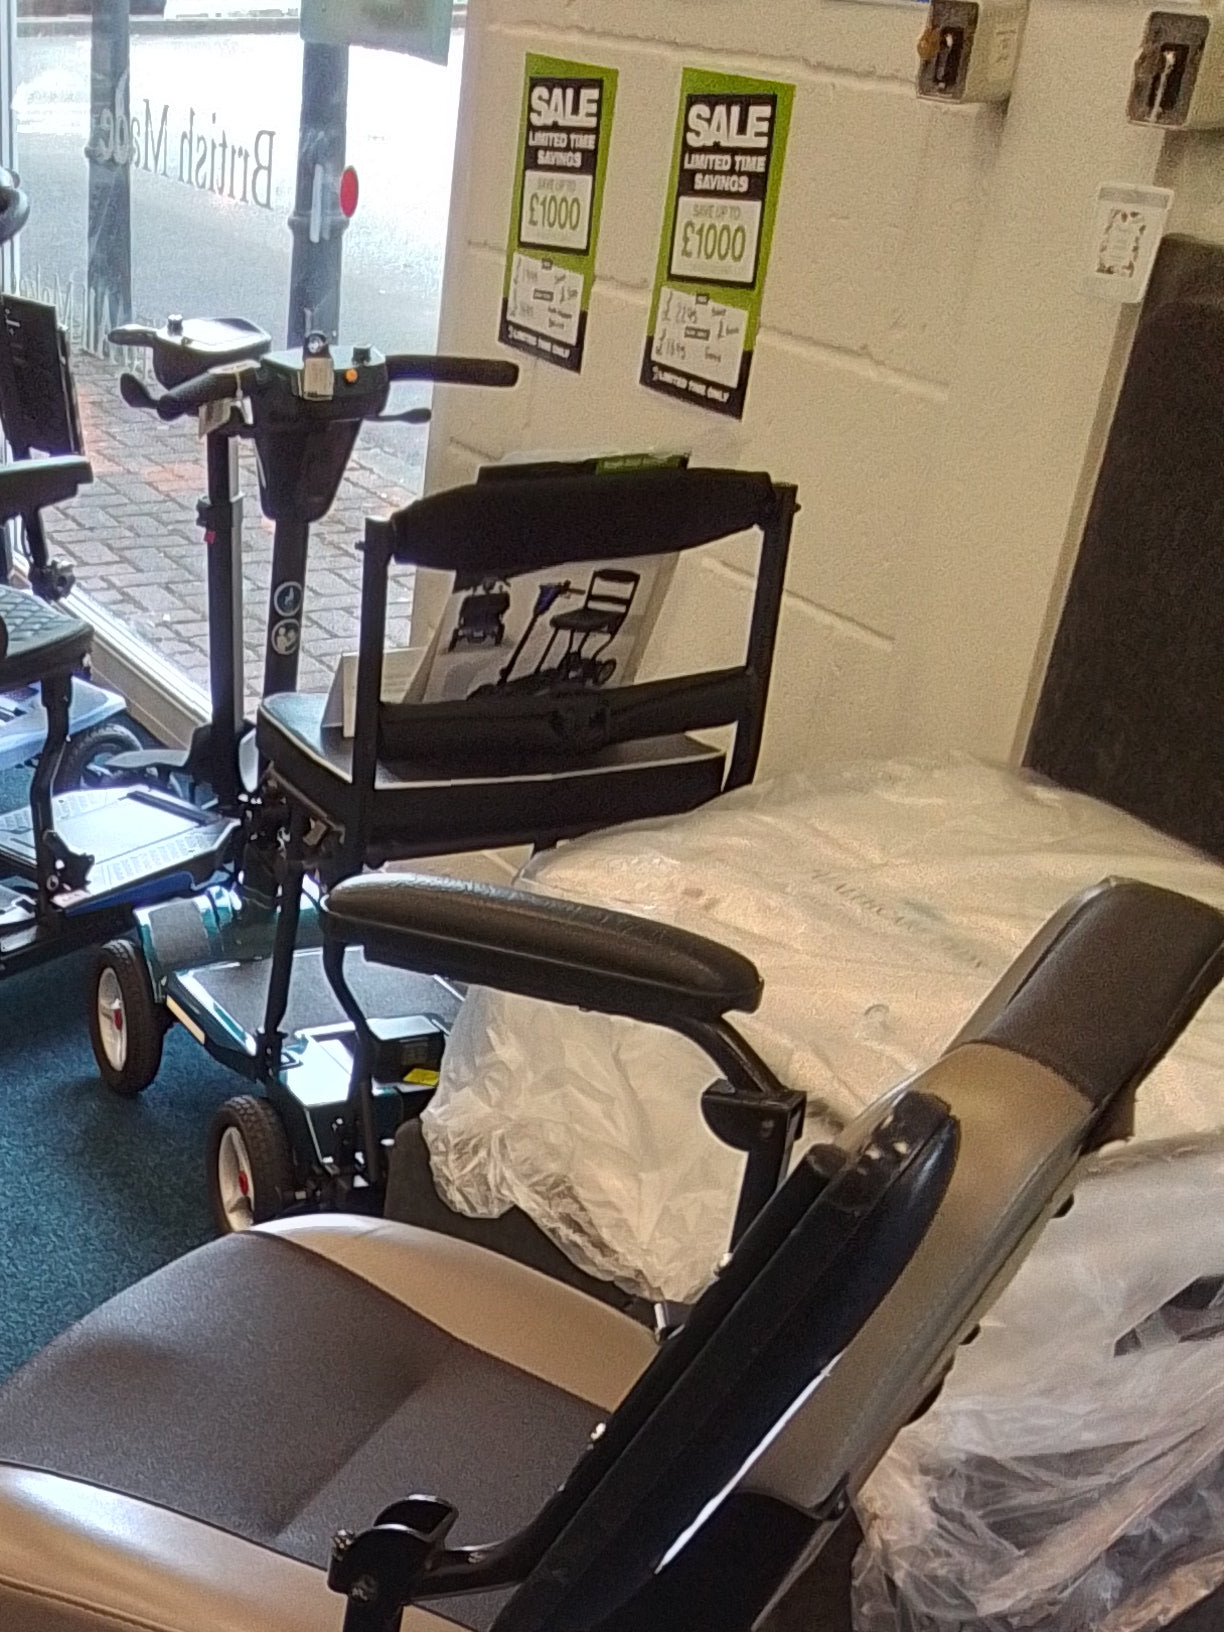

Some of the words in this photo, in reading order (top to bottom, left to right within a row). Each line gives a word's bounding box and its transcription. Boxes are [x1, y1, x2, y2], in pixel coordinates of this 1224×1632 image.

[529, 86, 600, 128] SALE
[686, 104, 772, 148] SALE
[528, 131, 568, 148] LIMITED
[570, 134, 596, 150] TIME
[537, 150, 582, 168] SAVINGS
[683, 153, 731, 171] LIMITED
[734, 155, 766, 173] TIME
[694, 173, 749, 192] SAVINGS
[528, 192, 581, 231] £1000
[693, 204, 715, 218] SAVE
[715, 205, 728, 219] UP
[728, 206, 741, 219] TO
[681, 220, 746, 263] £1000
